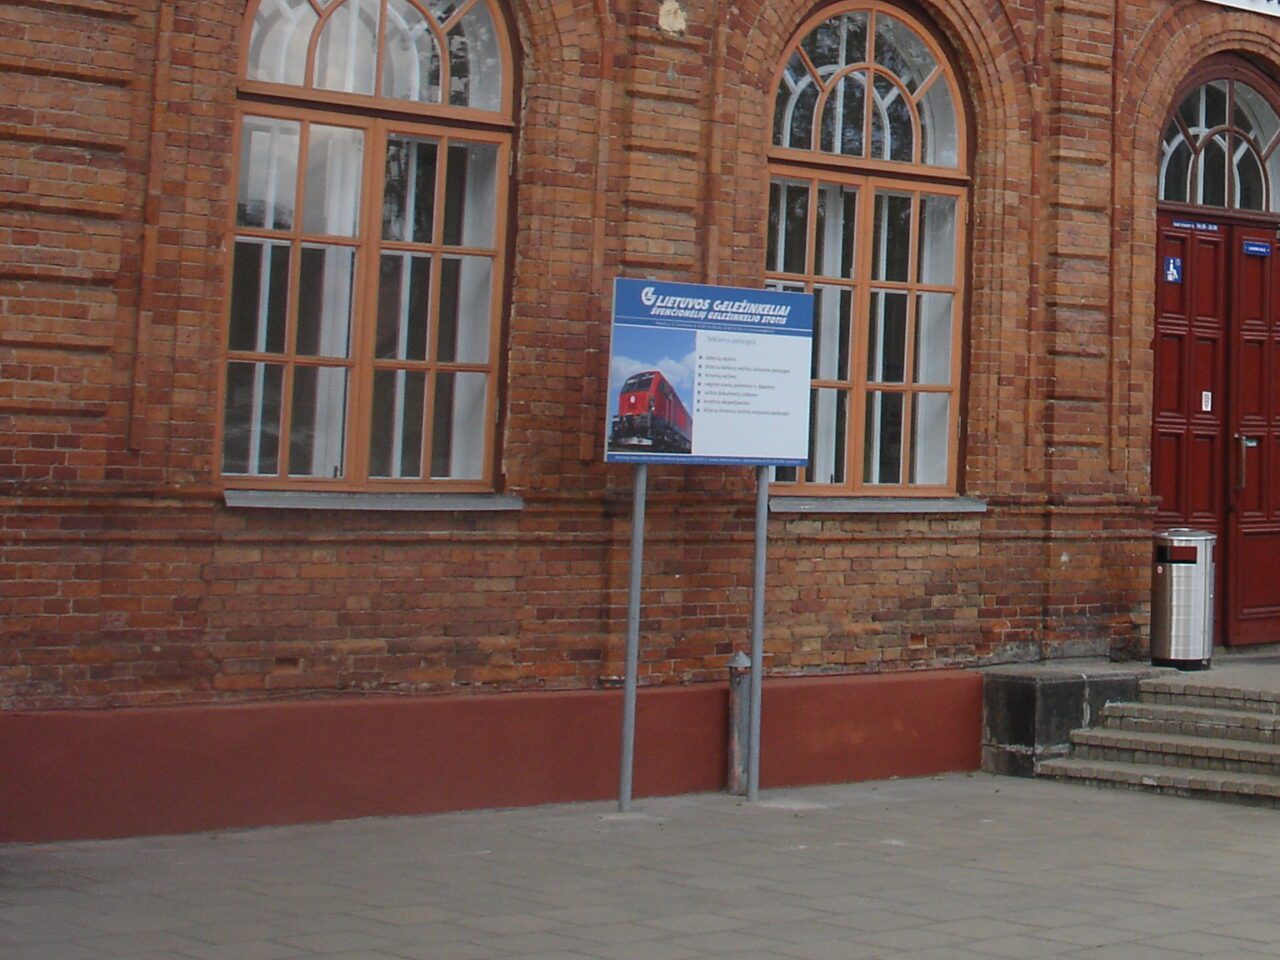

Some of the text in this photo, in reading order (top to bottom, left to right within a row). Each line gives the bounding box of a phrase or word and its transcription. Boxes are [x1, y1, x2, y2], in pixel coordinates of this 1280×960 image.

[655, 294, 711, 310] LIETUVOS
[713, 299, 792, 316] GELEŽINKELIAI
[708, 311, 761, 323] GELEŽINKELIO
[761, 315, 788, 324] STOTIS
